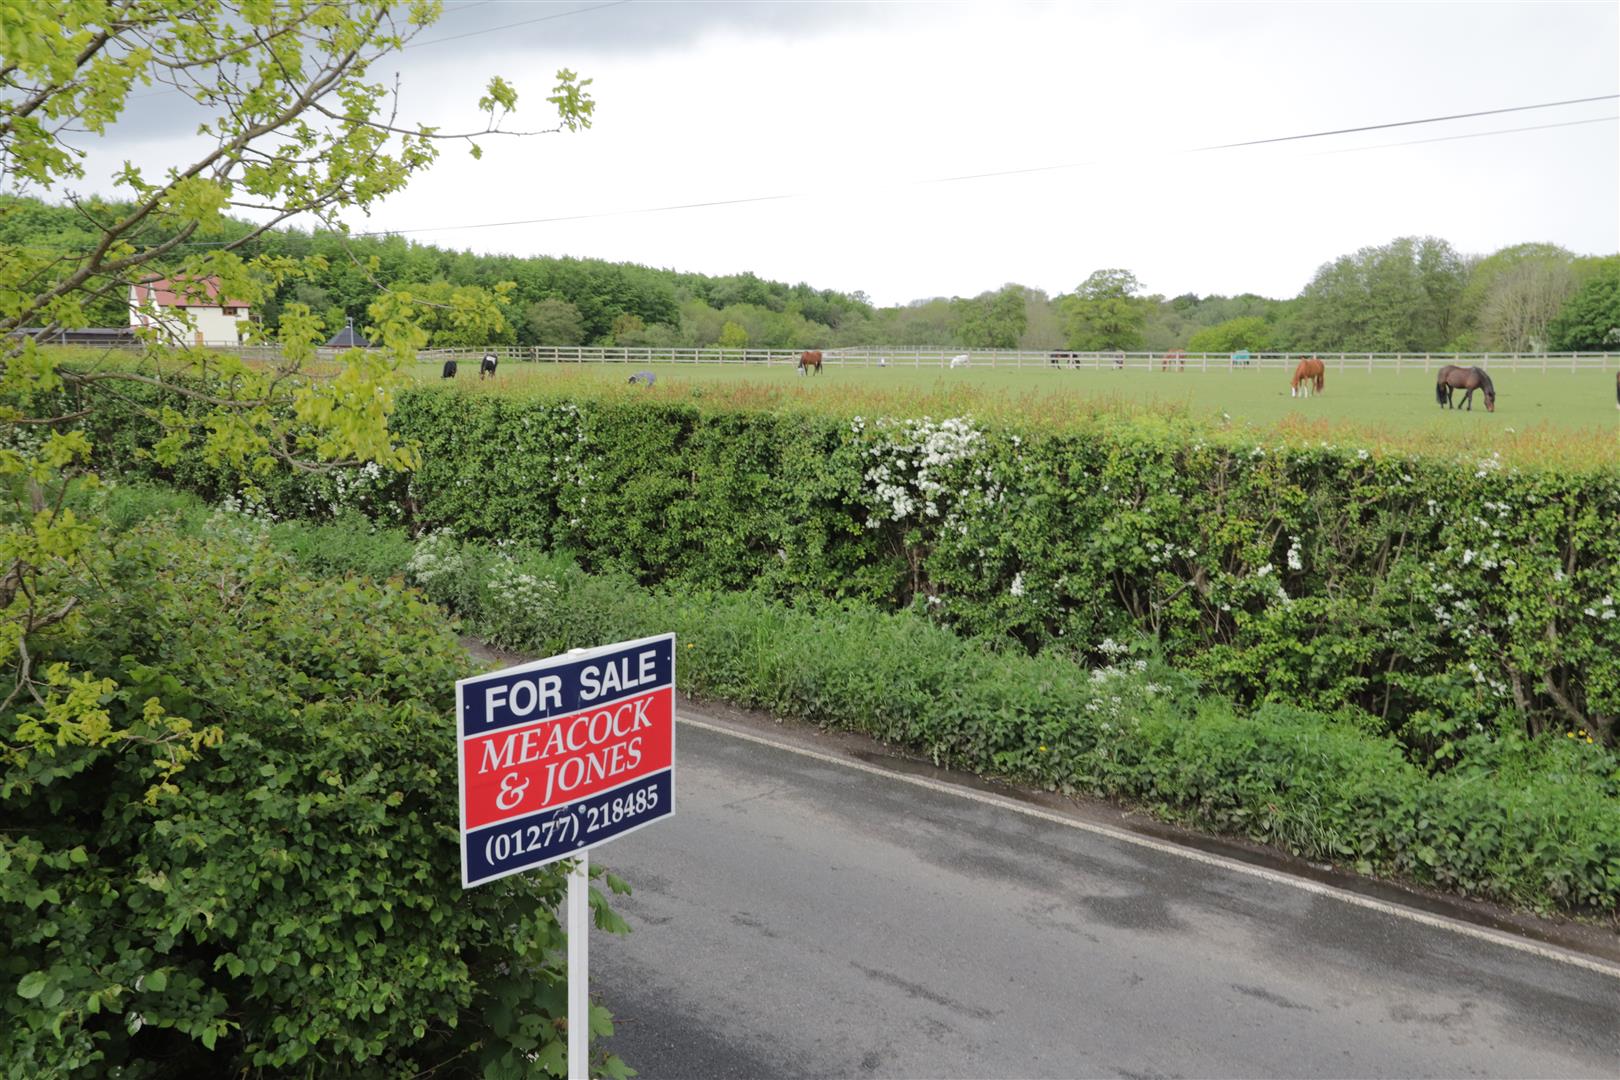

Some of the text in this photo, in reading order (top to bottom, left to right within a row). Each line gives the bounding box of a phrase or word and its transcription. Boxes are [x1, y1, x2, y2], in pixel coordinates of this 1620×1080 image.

[485, 650, 657, 723] FOR SALE
[478, 696, 654, 774] MEACOCK
[496, 737, 642, 811] & JONES
[485, 784, 659, 865] (01277) 218485
